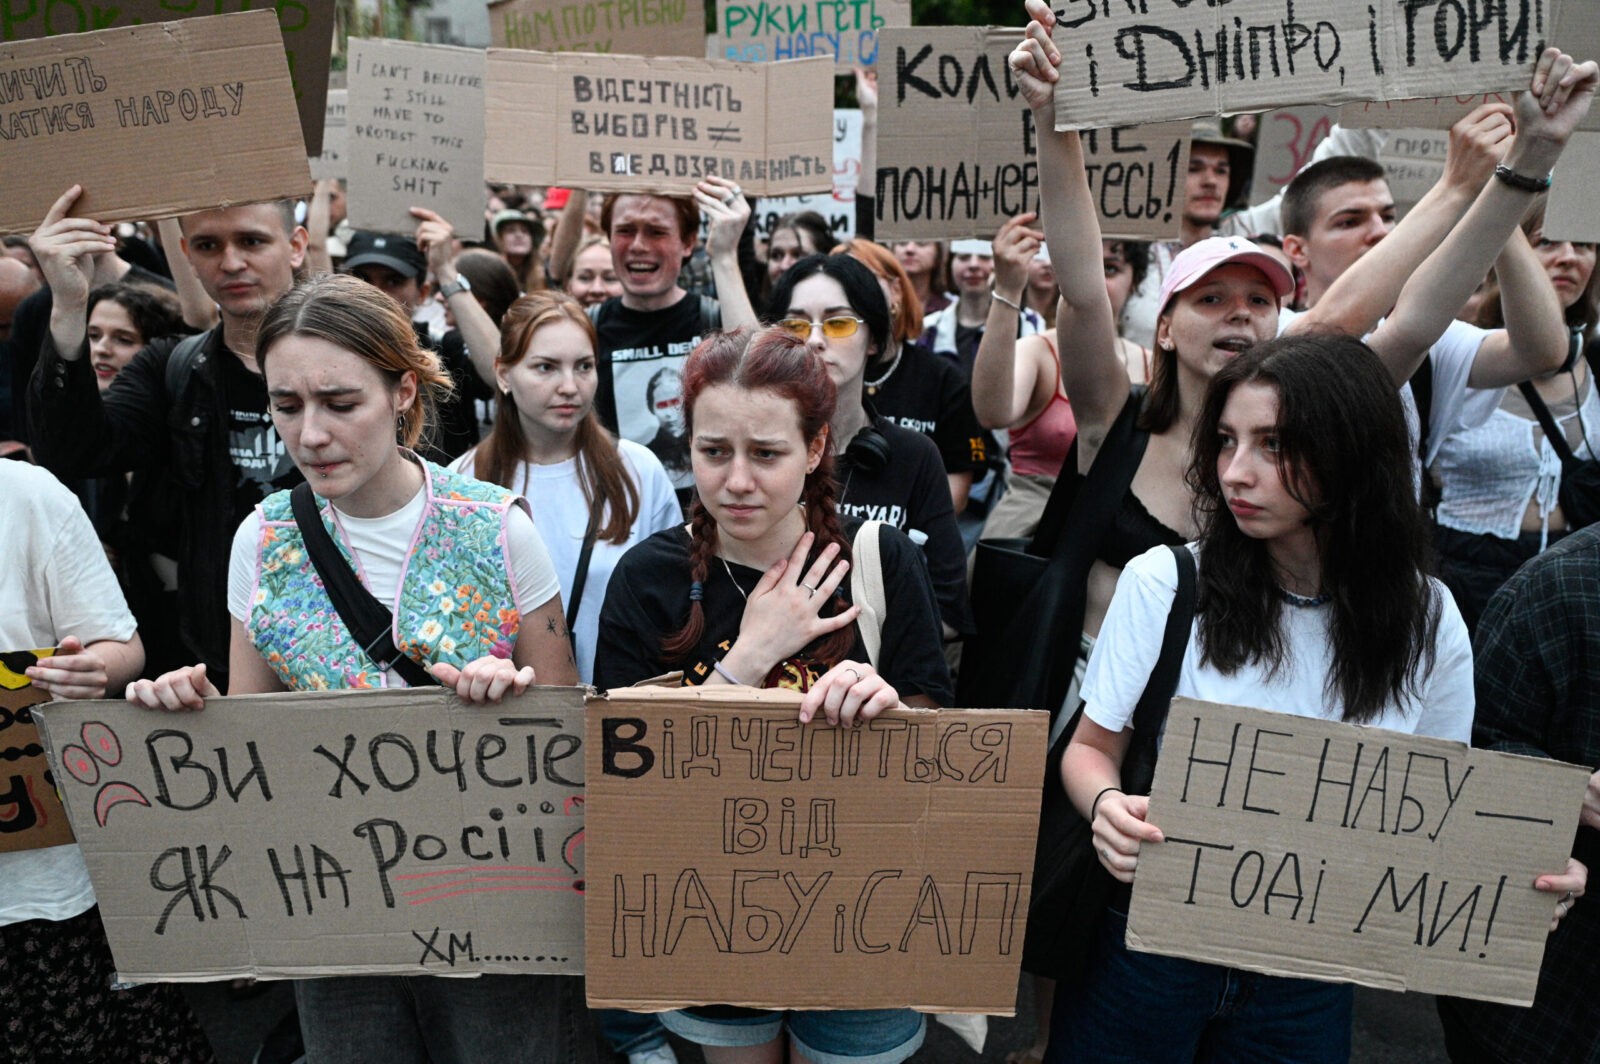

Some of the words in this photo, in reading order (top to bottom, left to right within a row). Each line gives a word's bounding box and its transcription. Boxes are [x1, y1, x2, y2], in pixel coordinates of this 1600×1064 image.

[725, 1, 808, 38] РУКИ
[371, 63, 412, 82] CAN'T
[423, 70, 483, 89] BELIEVE
[573, 75, 742, 113] ВІДСУТНІСТЬ
[115, 82, 244, 128] НАРОДУ
[373, 107, 413, 122] HAVE
[424, 112, 444, 125] TO
[356, 125, 417, 144] PROTEST
[571, 110, 698, 141] ВИБОРІВ
[612, 345, 663, 361] SMALL
[145, 728, 273, 810] ВИ
[1180, 717, 1294, 816] НЕ
[1306, 738, 1475, 842] НАБУ
[150, 844, 248, 935] ЯК
[267, 843, 352, 916] НА
[612, 868, 833, 957] НАБУ
[853, 870, 1022, 955] САП
[1353, 866, 1508, 959] МИ!
